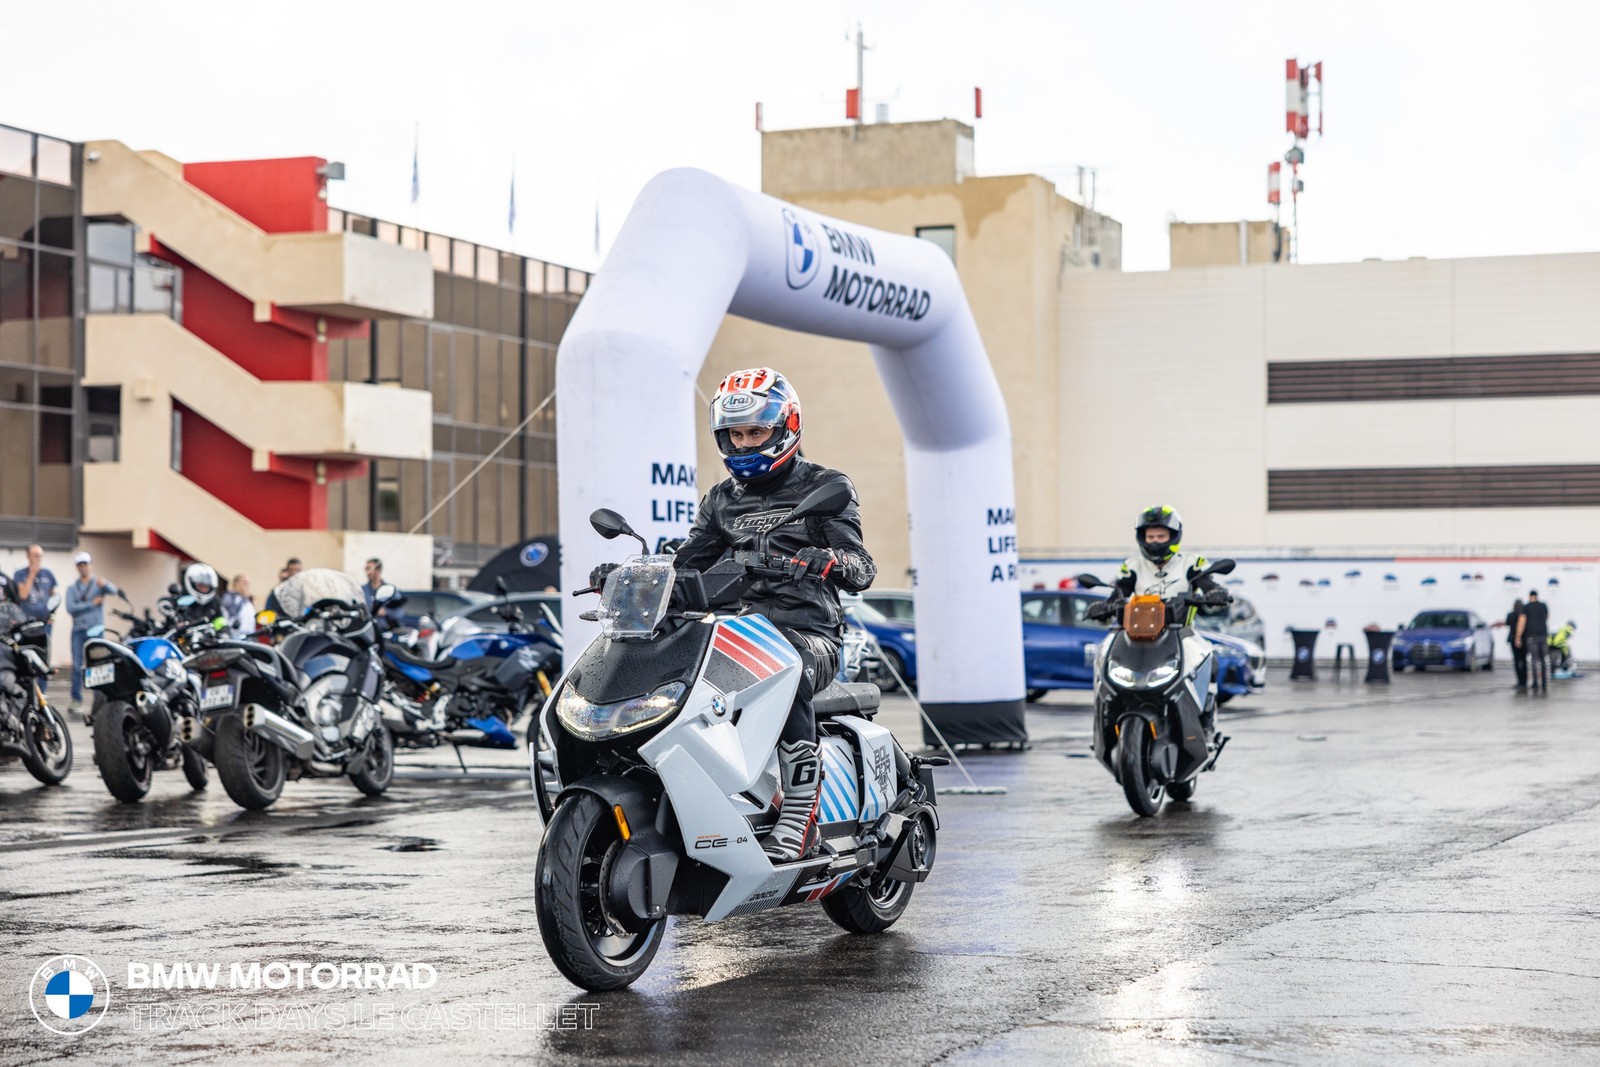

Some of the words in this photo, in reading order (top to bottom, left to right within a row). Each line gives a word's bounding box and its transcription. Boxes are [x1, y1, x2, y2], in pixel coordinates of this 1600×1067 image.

[820, 223, 876, 266] BMW
[823, 265, 931, 322] MOTORRAD
[726, 395, 750, 406] Arai
[651, 500, 696, 524] LIFE
[991, 564, 1004, 582] A
[873, 745, 889, 764] BOL
